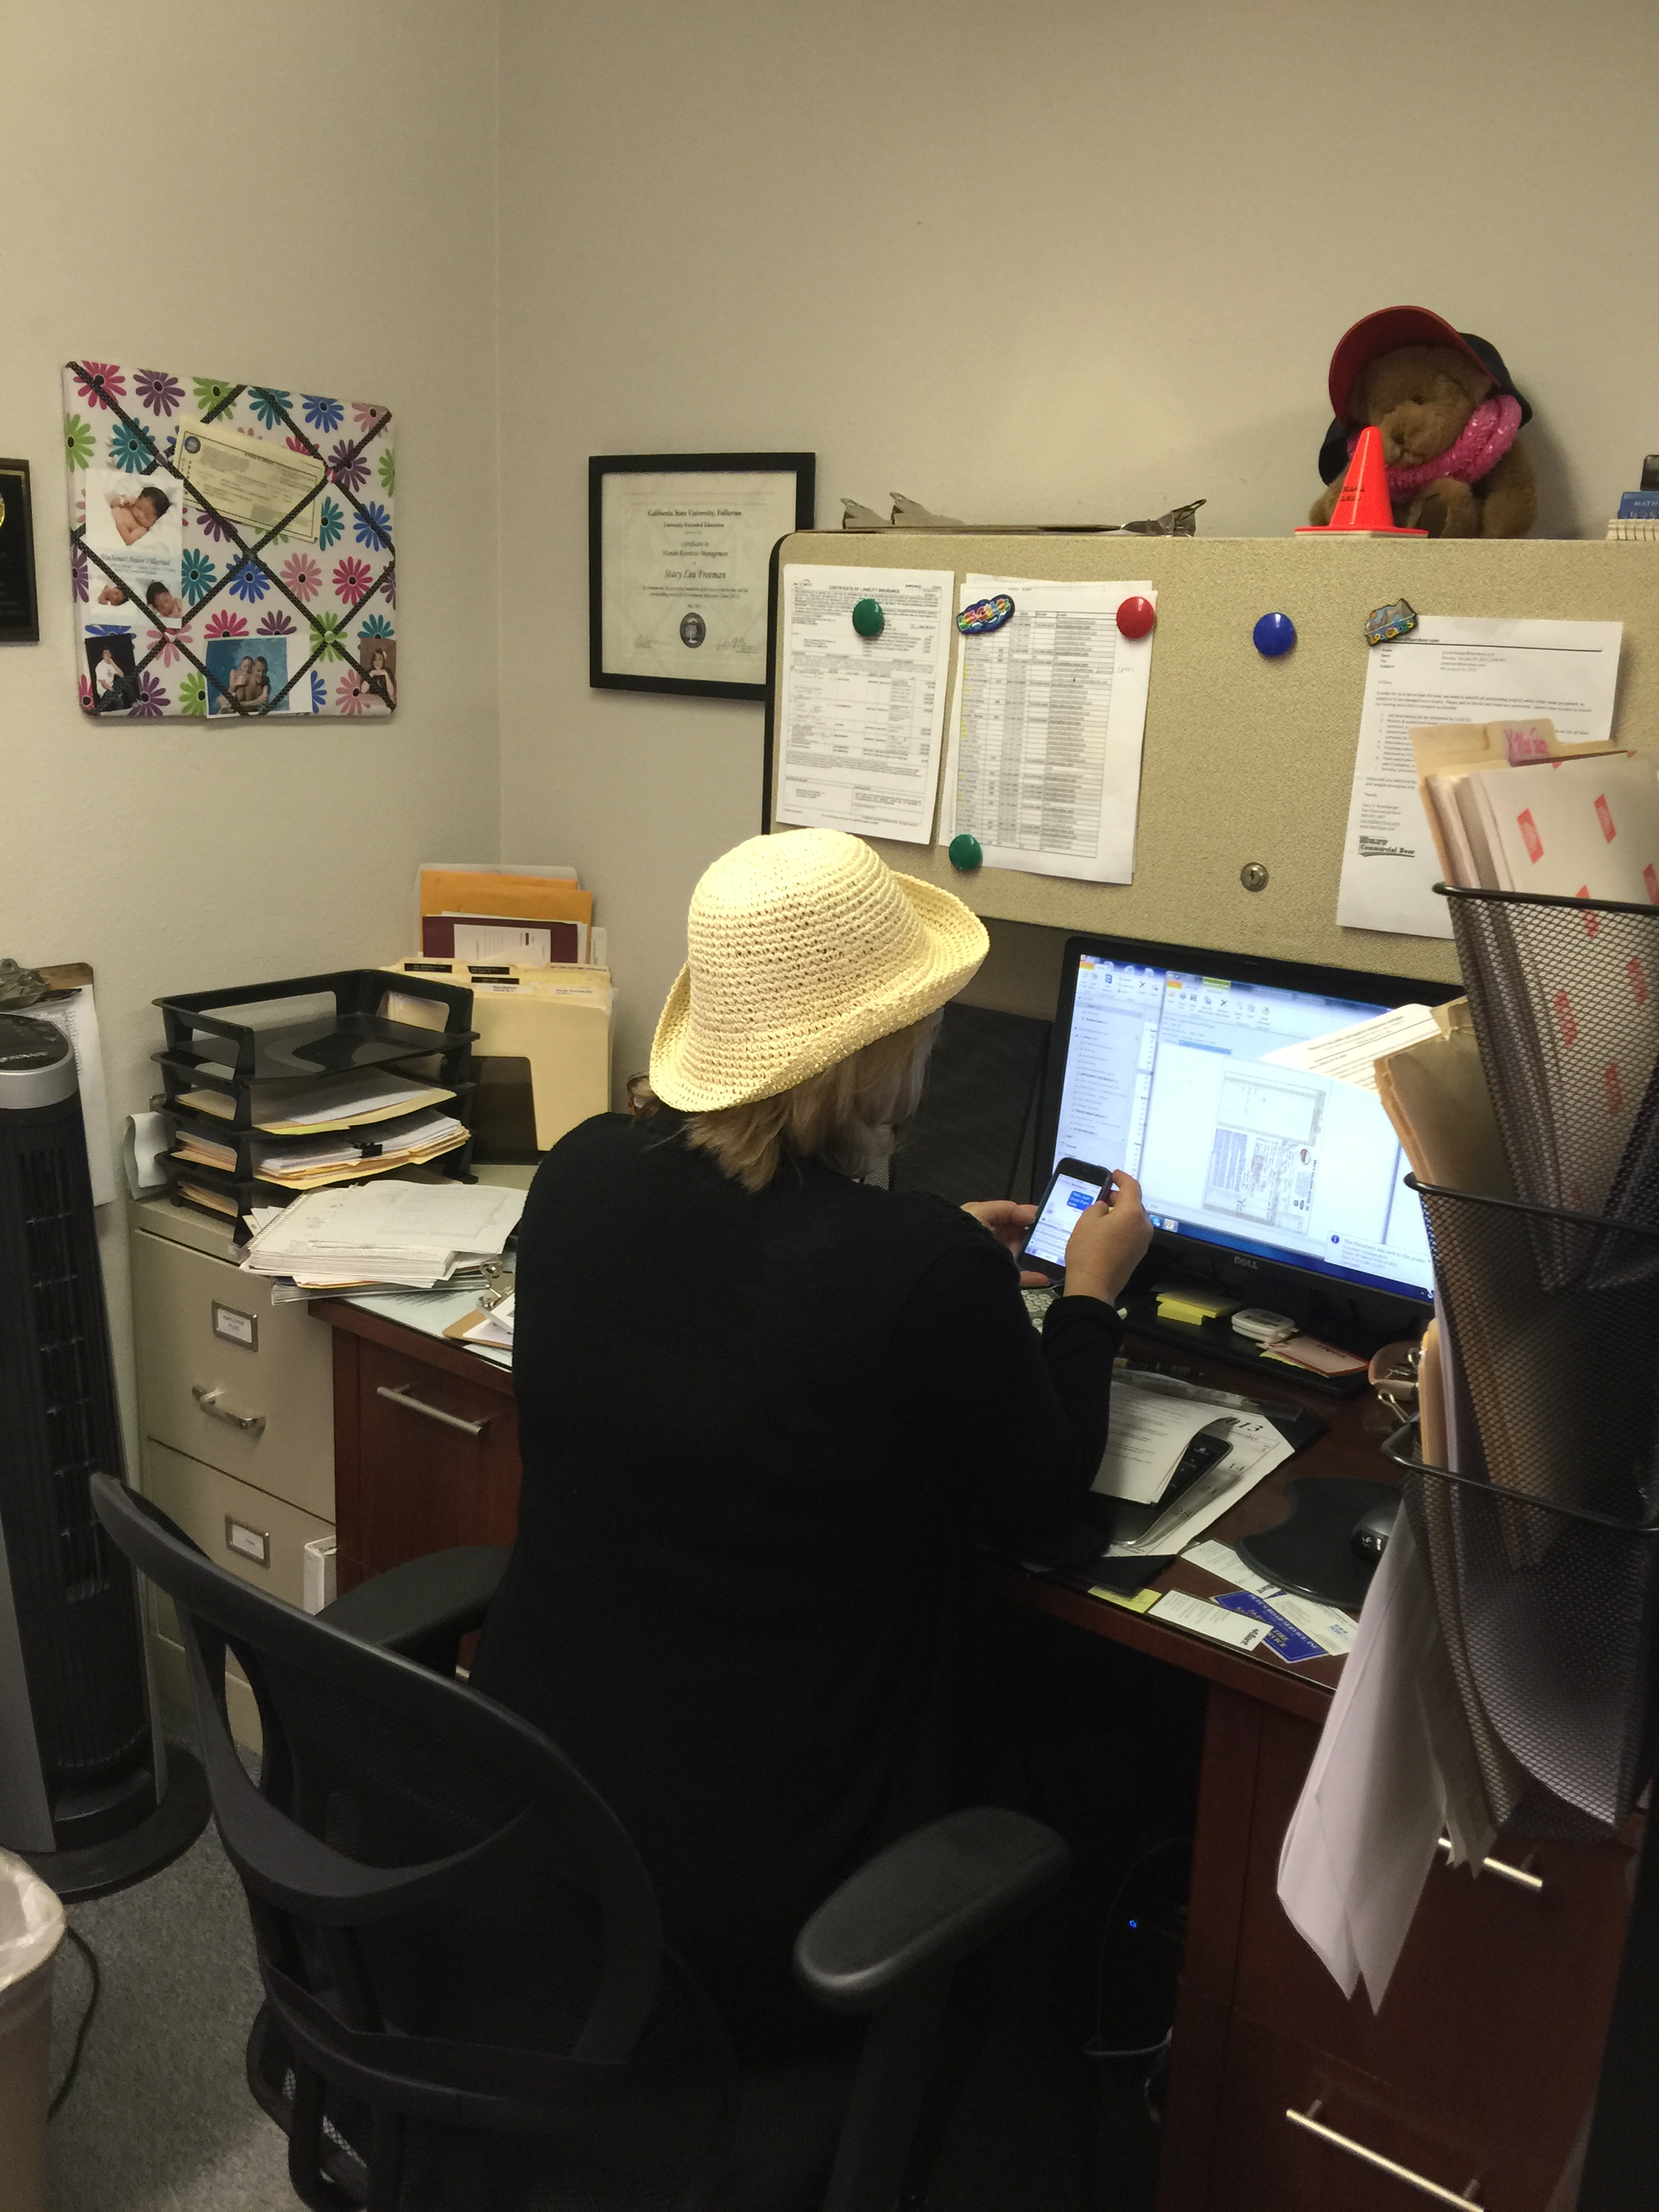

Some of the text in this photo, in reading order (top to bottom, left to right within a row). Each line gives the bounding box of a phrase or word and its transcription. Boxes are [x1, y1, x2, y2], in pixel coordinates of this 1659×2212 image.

[648, 509, 673, 517] California
[664, 569, 682, 581] Stacy
[697, 569, 726, 579] Freeman
[1368, 619, 1414, 644] Los Cabos
[1360, 844, 1397, 853] Commercial
[1353, 1241, 1376, 1250] document
[1234, 1256, 1258, 1269] DELL
[1229, 1463, 1245, 1471] 14
[1267, 1608, 1284, 1622] ROAD
[1272, 1629, 1290, 1642] TIRE
